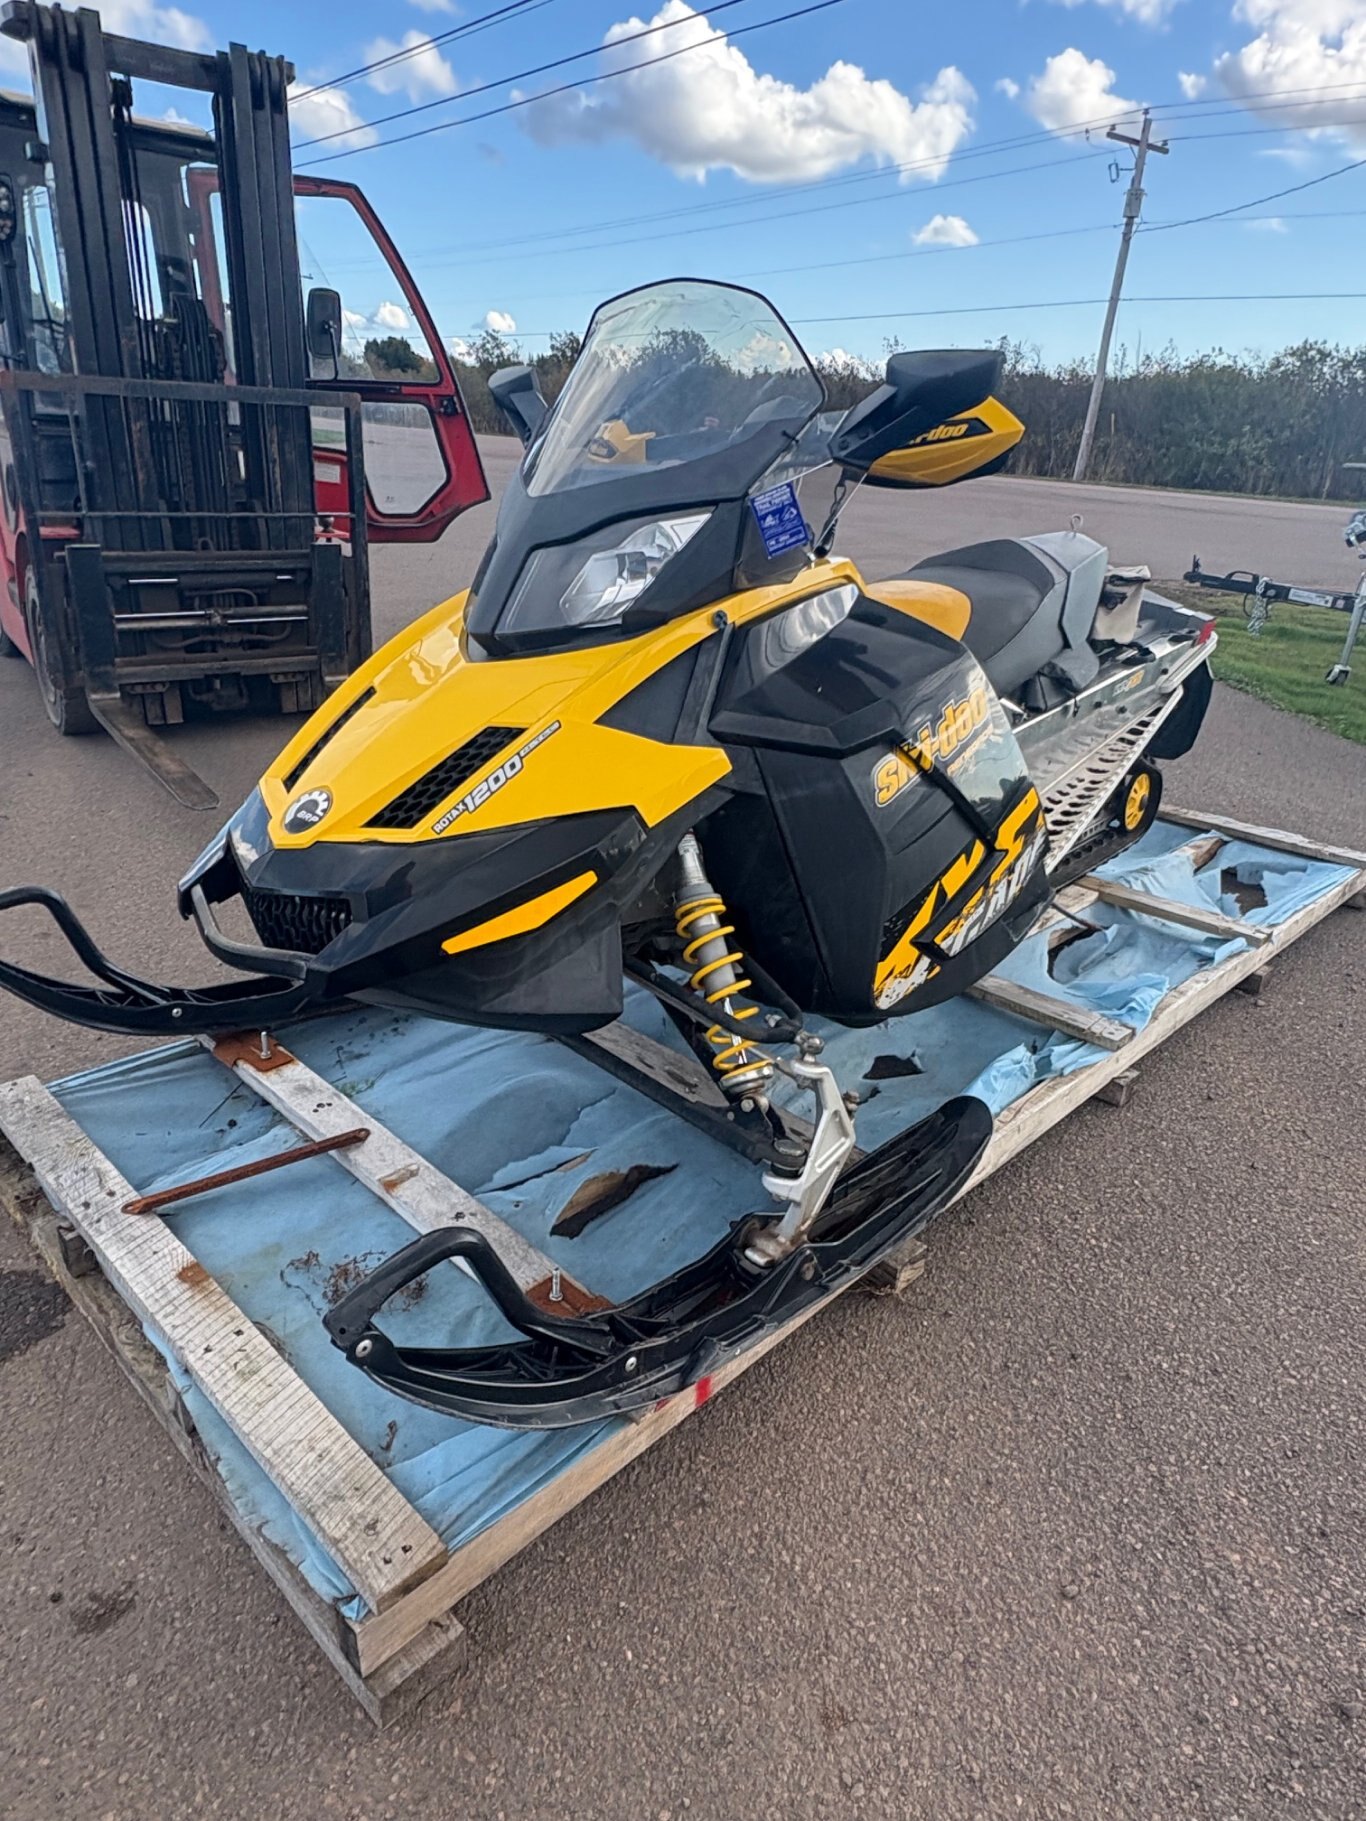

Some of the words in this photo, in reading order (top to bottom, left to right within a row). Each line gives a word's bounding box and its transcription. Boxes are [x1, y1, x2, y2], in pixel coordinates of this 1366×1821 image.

[296, 810, 319, 822] BRP
[432, 801, 467, 833] ROTAX
[463, 753, 523, 813] 1200
